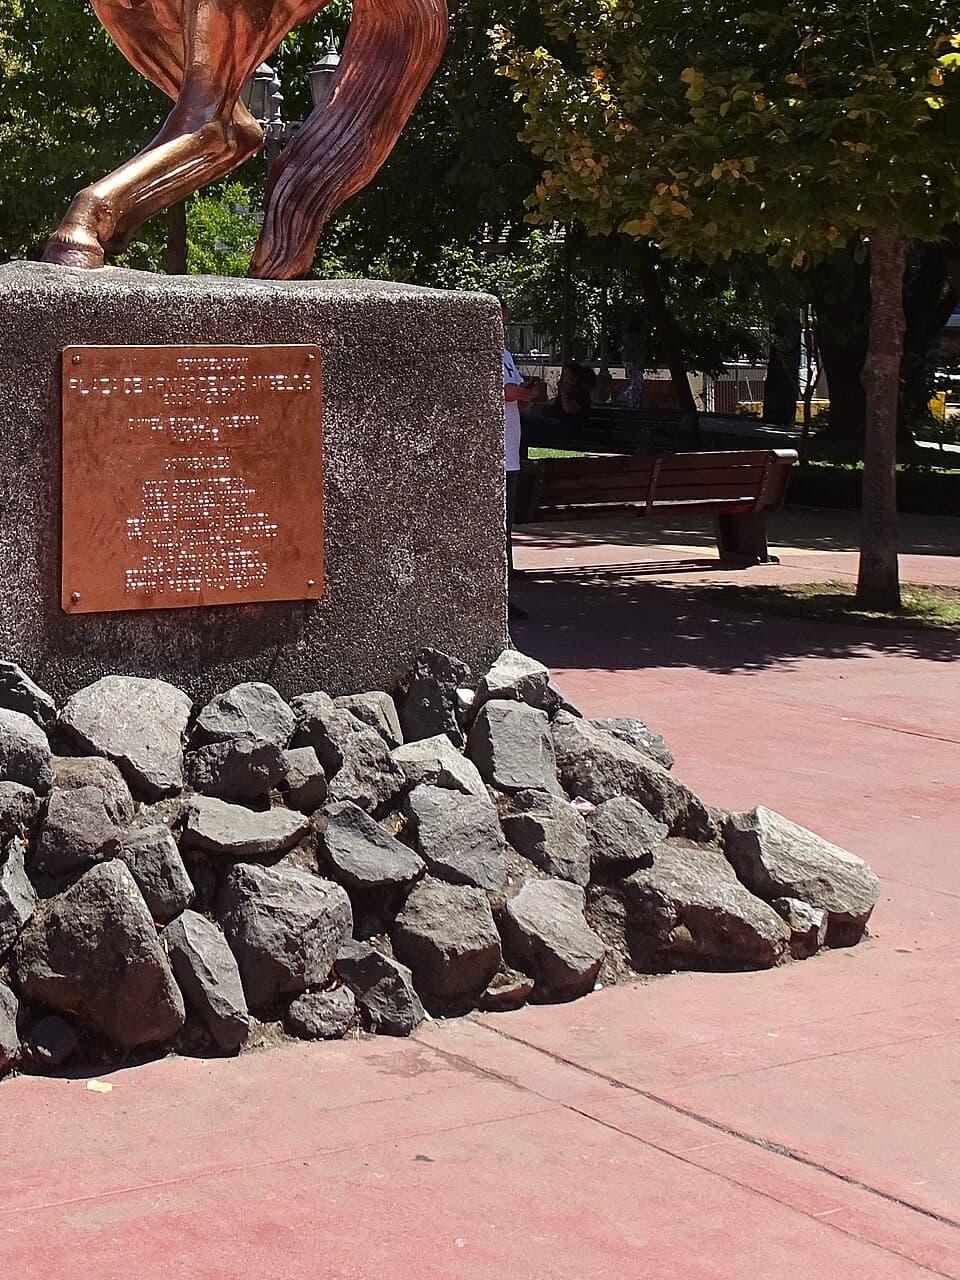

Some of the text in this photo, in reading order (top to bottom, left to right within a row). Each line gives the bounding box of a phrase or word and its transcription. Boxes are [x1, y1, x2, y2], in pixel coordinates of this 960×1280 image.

[69, 378, 118, 395] PLAZA
[123, 377, 143, 394] DE
[147, 376, 195, 392] ARMAS
[198, 375, 218, 392] DE
[219, 375, 246, 392] LOS
